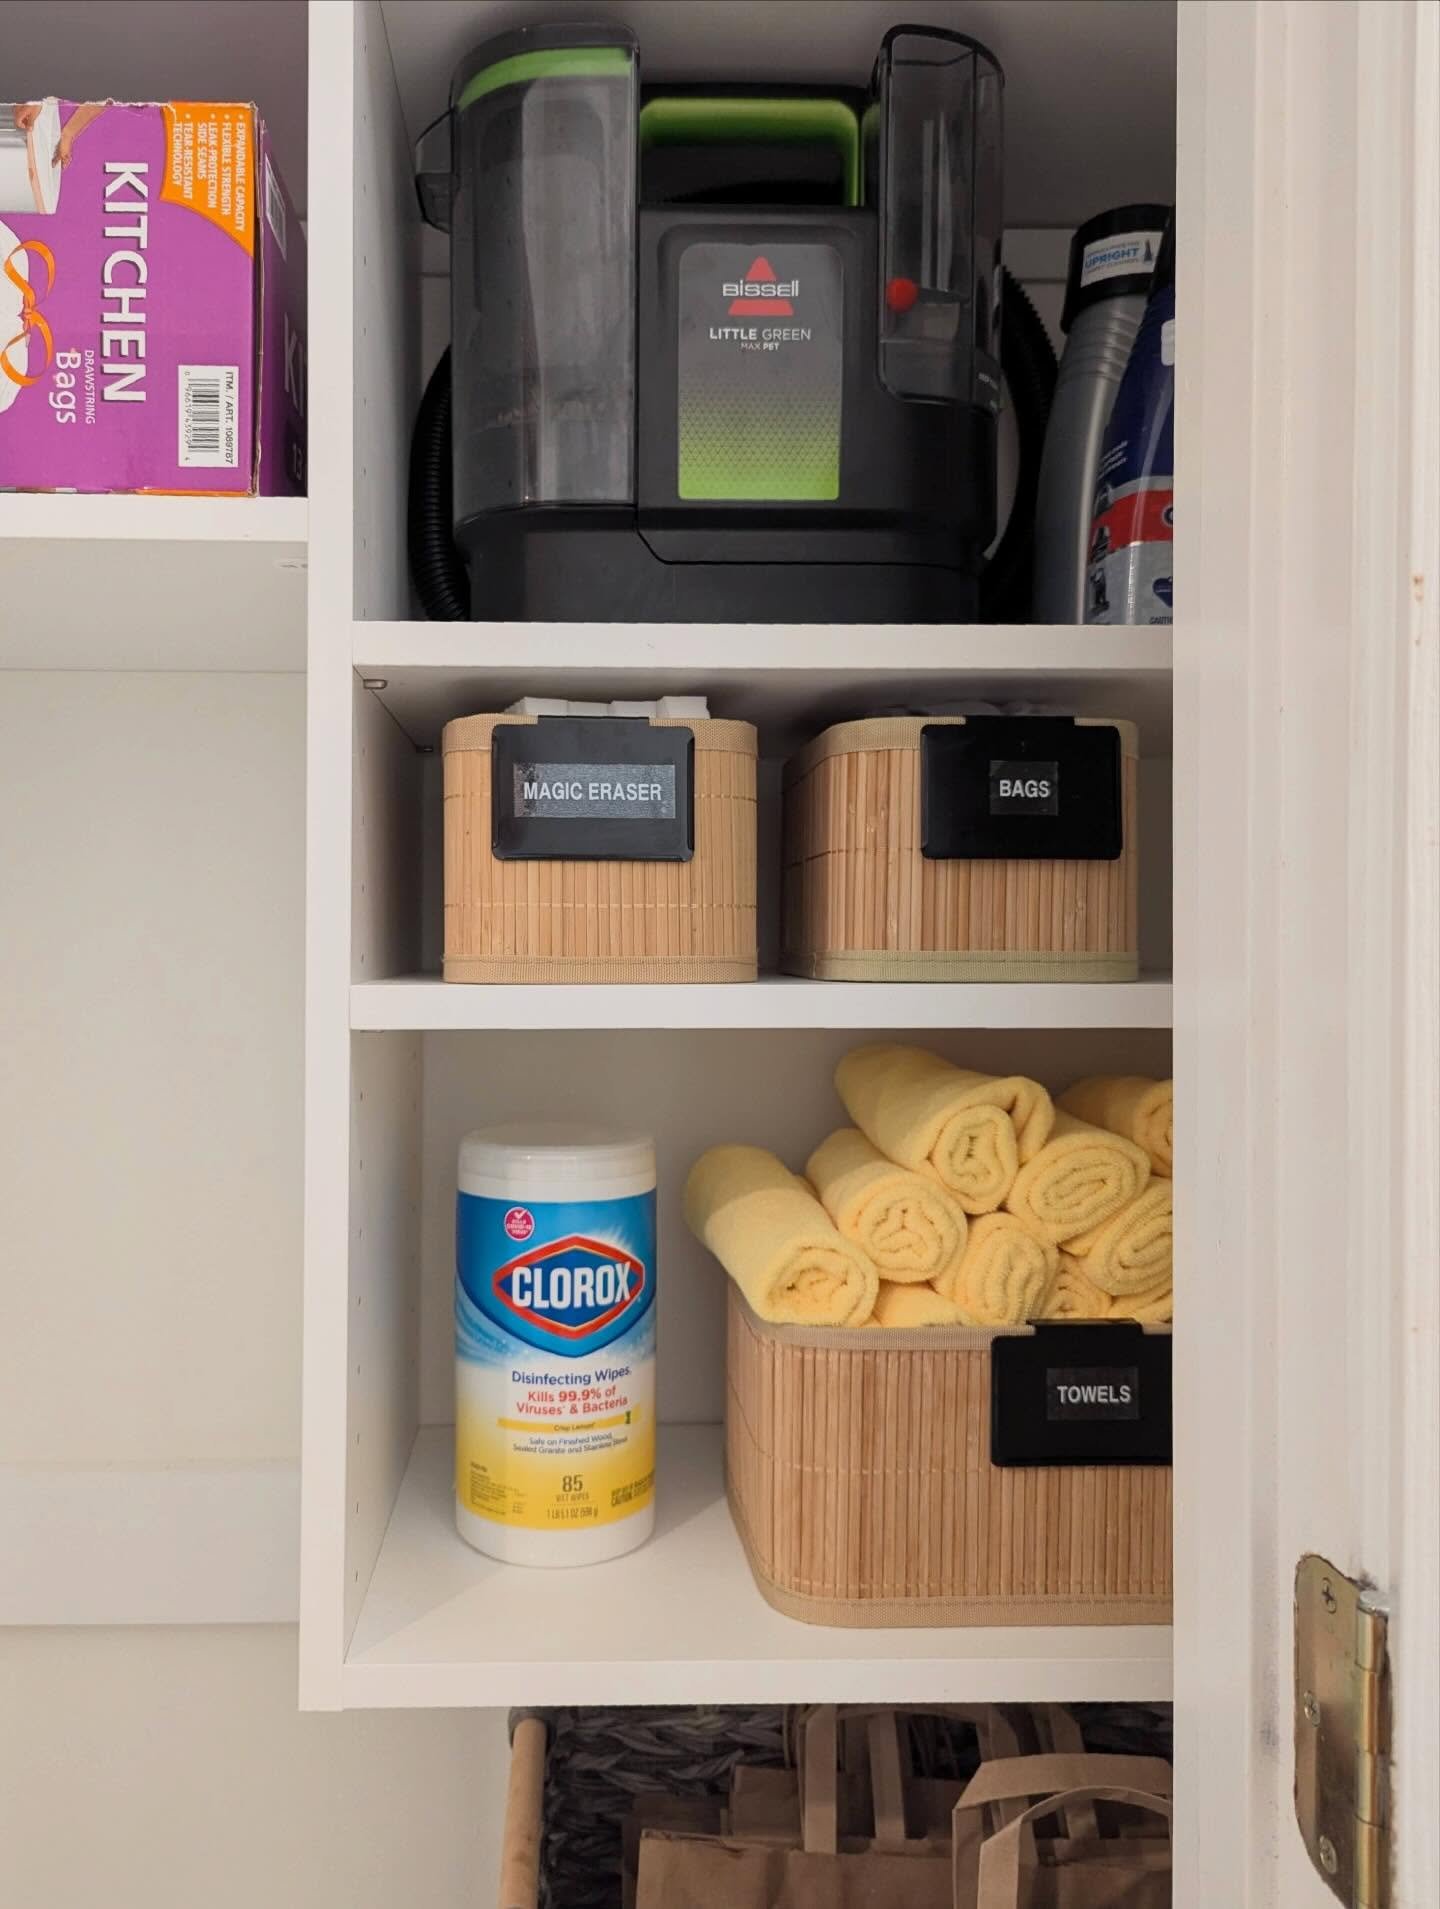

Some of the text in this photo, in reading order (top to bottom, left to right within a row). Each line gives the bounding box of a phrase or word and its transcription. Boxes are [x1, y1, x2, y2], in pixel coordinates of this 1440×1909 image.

[172, 122, 183, 186] TECHNOLOGY
[183, 122, 193, 200] TEAR-RESISTANT
[197, 122, 207, 180] SIDE SEAMS
[207, 122, 217, 208] LEAK-PROTECTION
[221, 122, 232, 216] FLEXIBLE STRENGTH
[235, 122, 246, 232] EXPANDABLE CAPACITY
[1085, 247, 1139, 268] UPRIGHT
[102, 162, 149, 403] KITCHEN
[709, 327, 812, 341] LITTLE GREEN
[763, 342, 779, 351] PET
[49, 352, 78, 425] Bags
[84, 349, 96, 425] DRAWSTRING
[225, 401, 234, 423] ART.
[523, 782, 663, 801] MAGIC ERASER
[998, 779, 1051, 799] BAGS
[511, 1261, 632, 1309] CLOROX
[511, 1366, 631, 1386] Disinfecting Wipes
[527, 1385, 617, 1402] Kills 99.9% of
[1057, 1385, 1132, 1404] TOWELS
[569, 1402, 579, 1414] &
[582, 1396, 628, 1414] Bacteria
[562, 1474, 583, 1492] 85
